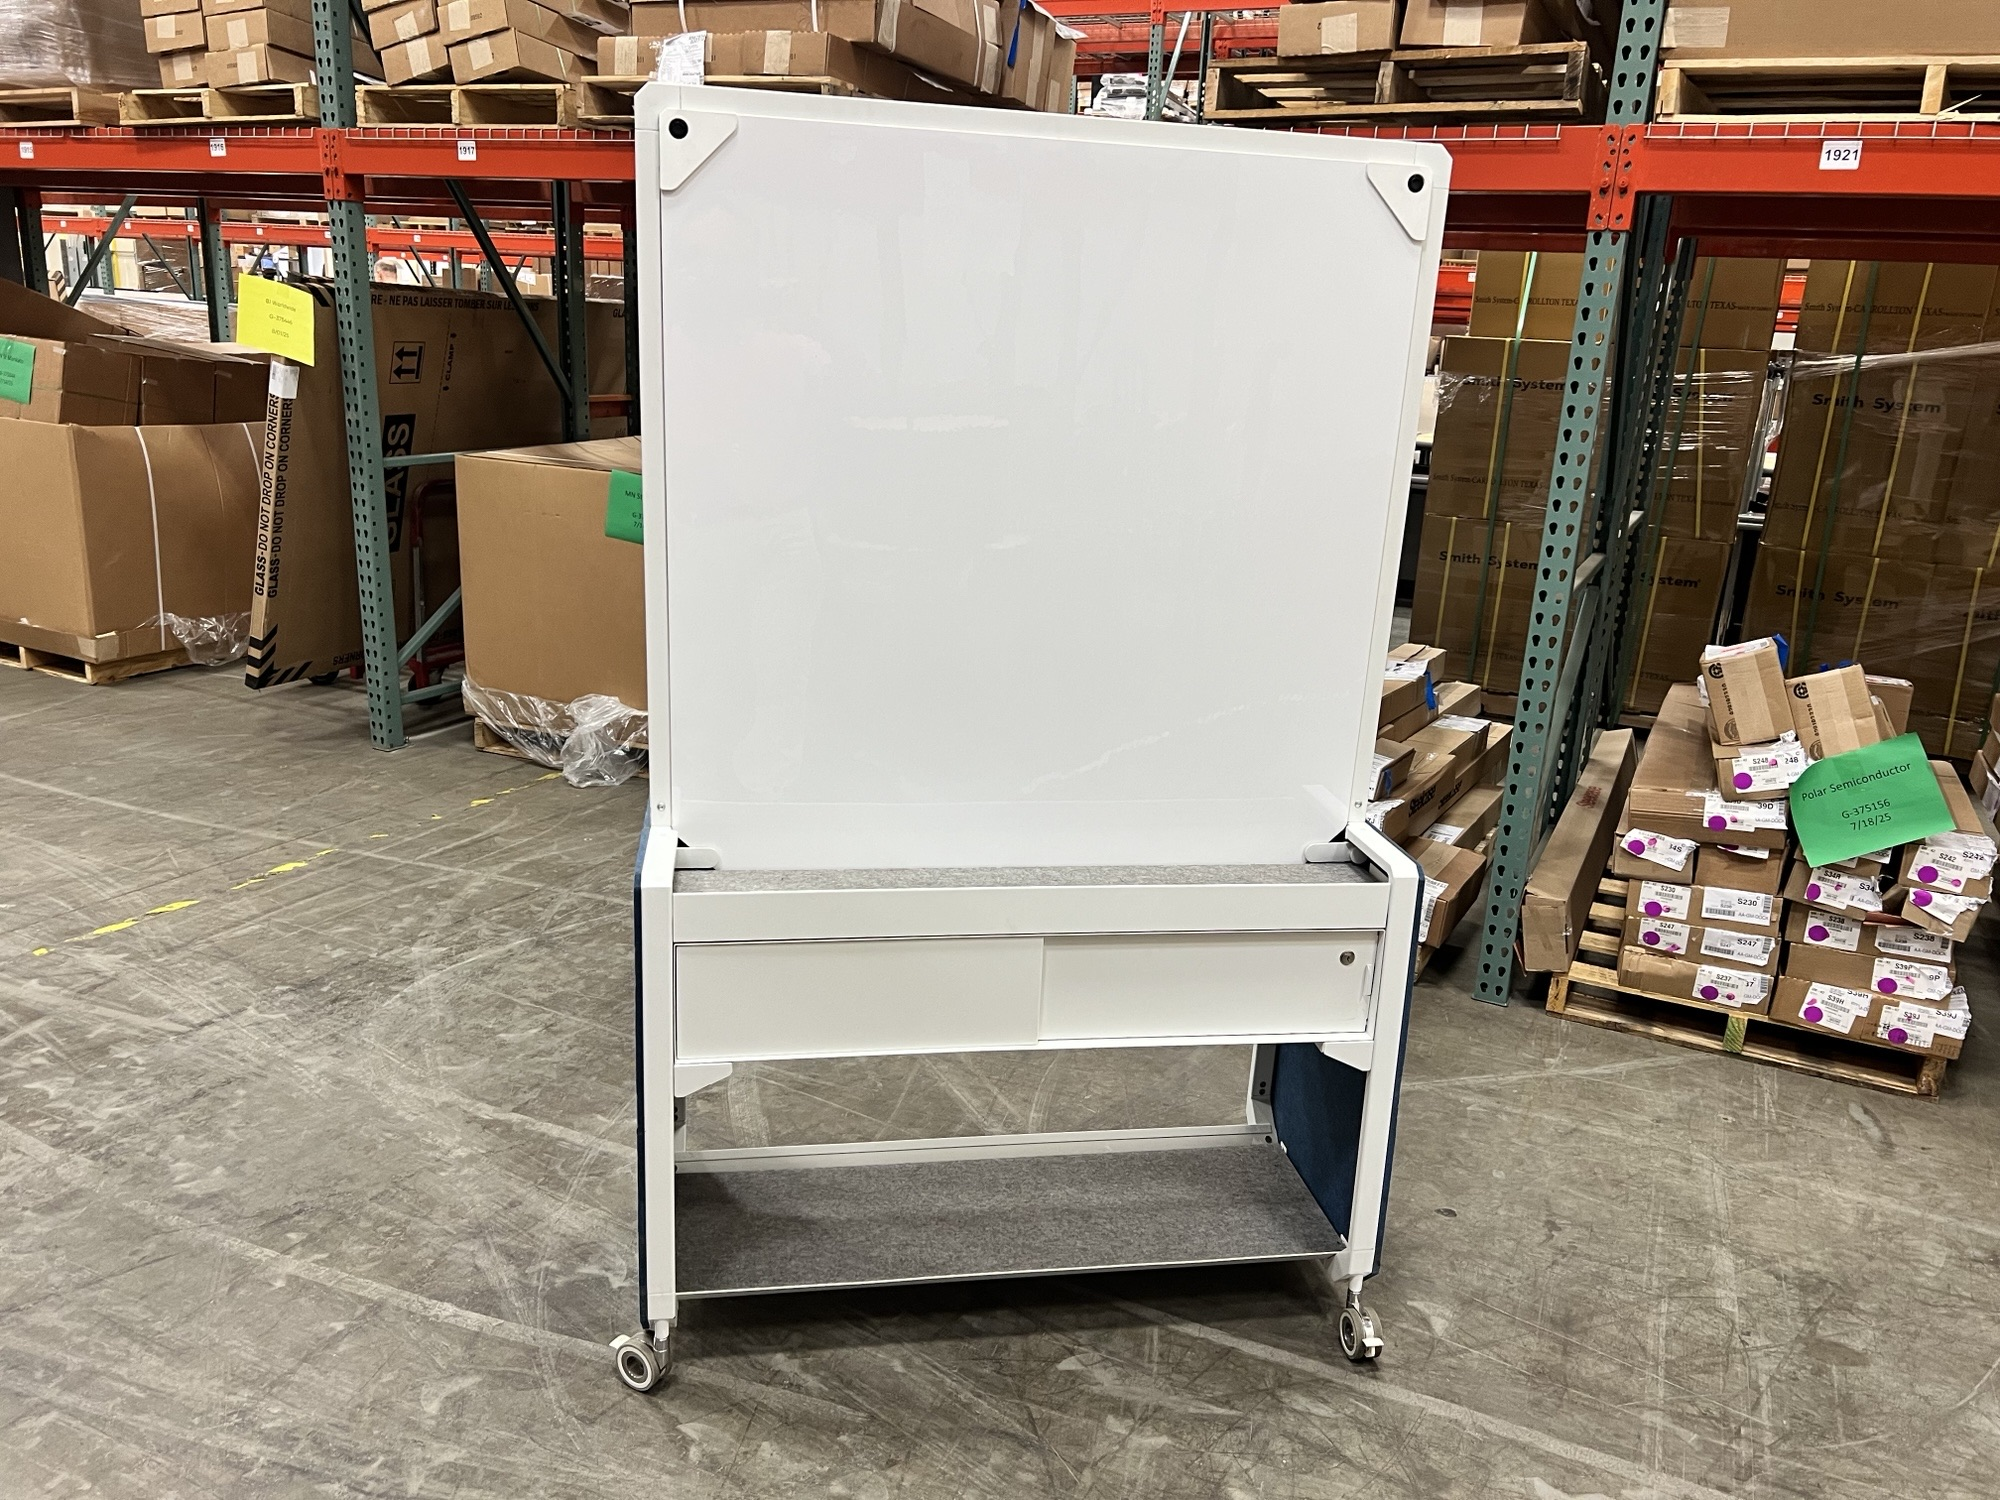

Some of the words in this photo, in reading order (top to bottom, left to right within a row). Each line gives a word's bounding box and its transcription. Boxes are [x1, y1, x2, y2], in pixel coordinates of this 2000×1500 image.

[459, 146, 475, 155] 1917
[1825, 149, 1859, 161] 1921
[389, 295, 401, 305] NE
[402, 295, 418, 306] PAS
[420, 296, 451, 308] LAISSER
[454, 297, 485, 309] TOMBER
[487, 298, 501, 310] SUR
[445, 344, 455, 381] CLAMP
[264, 452, 275, 470] ON
[278, 455, 288, 472] ON
[262, 472, 273, 505] DROP
[275, 475, 287, 507] DROP
[625, 490, 636, 498] MN
[259, 507, 271, 531] NOT
[273, 511, 284, 533] NOT
[1439, 551, 1481, 564] Smith
[1833, 591, 1899, 610] Sysem
[1753, 757, 1769, 765] S248
[1802, 787, 1828, 802] Polar
[1830, 762, 1911, 793] Semiconductor
[1841, 799, 1891, 819] G-375156
[1850, 813, 1892, 830] 7/18/25
[1939, 852, 1957, 863] S242
[1660, 885, 1676, 894] S230
[1737, 897, 1757, 907] S230
[1828, 915, 1845, 924] S238
[1659, 922, 1675, 930] S247
[1737, 939, 1757, 947] S247
[1913, 932, 1936, 943] S238
[1716, 973, 1732, 982] S237
[1827, 994, 1845, 1004] S39H
